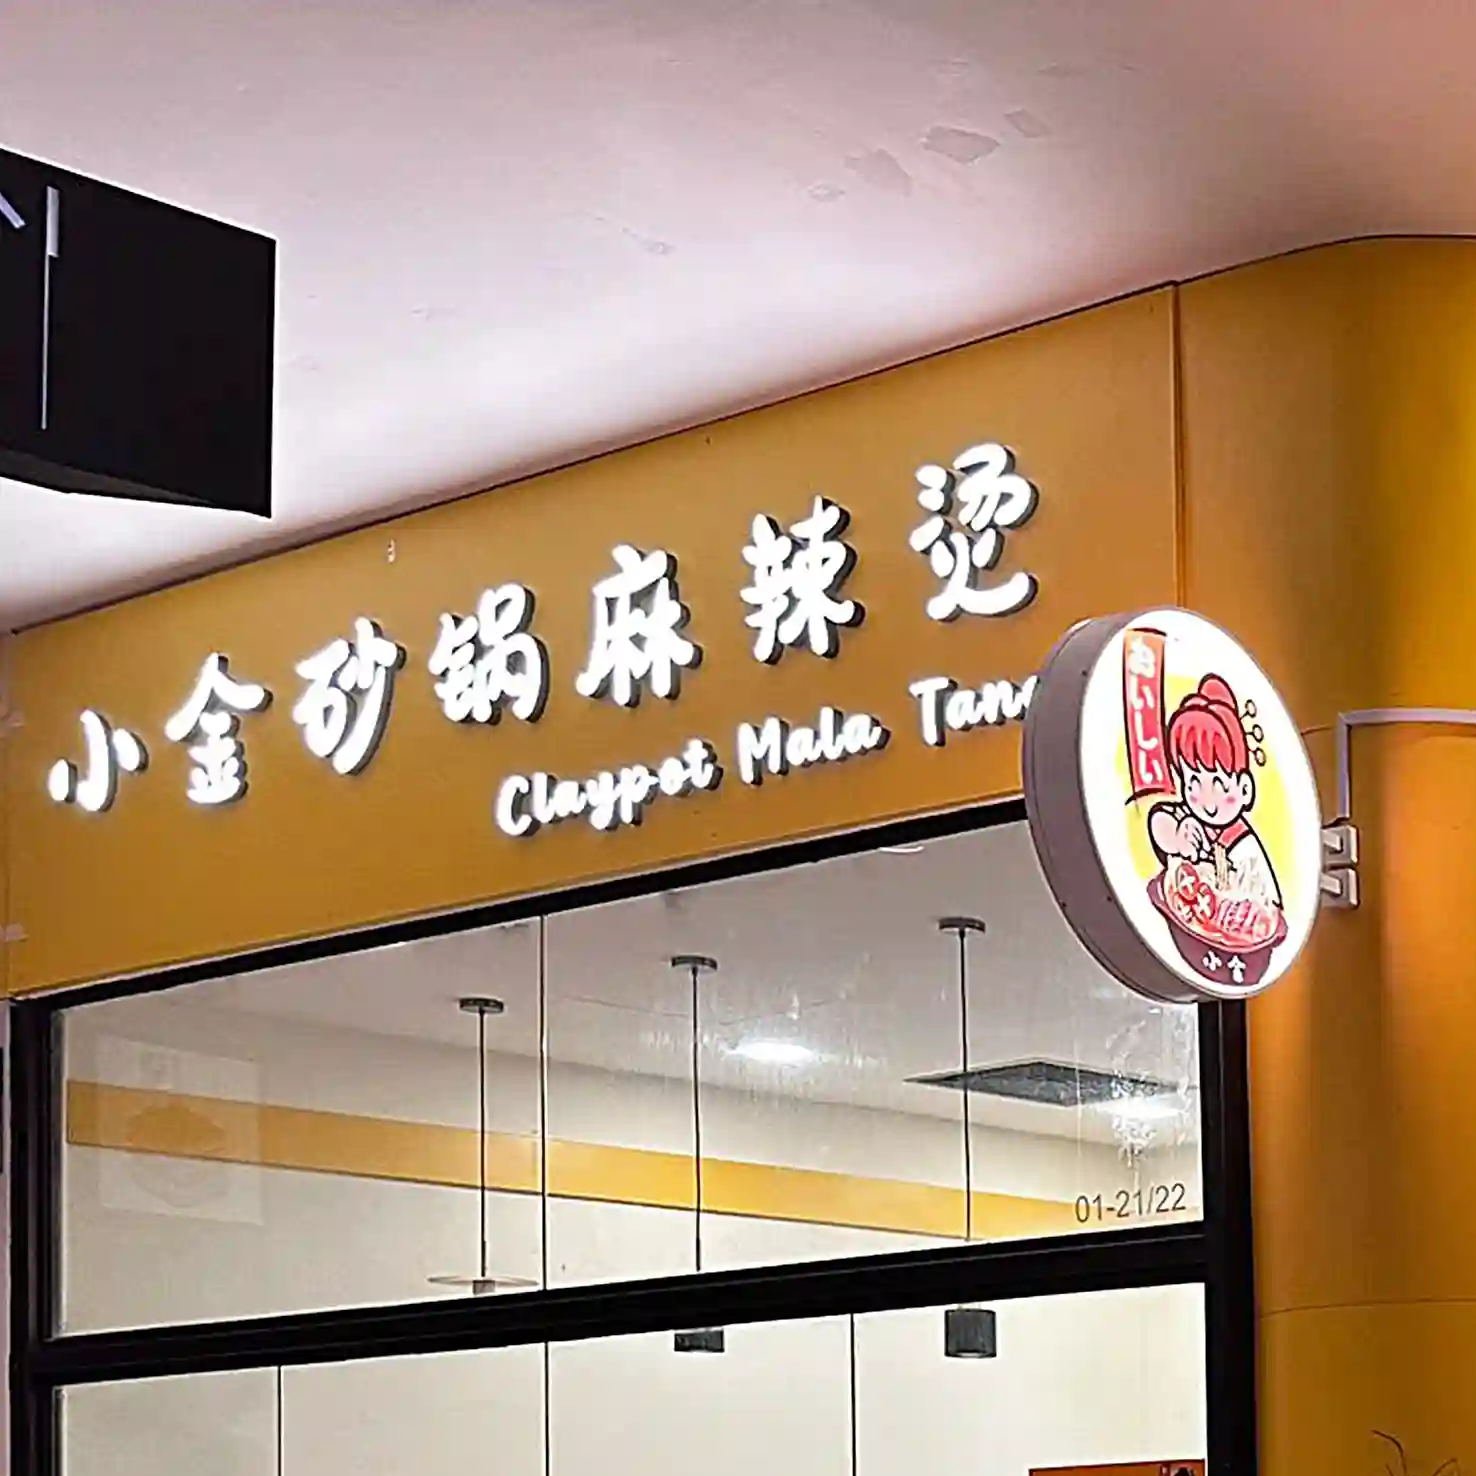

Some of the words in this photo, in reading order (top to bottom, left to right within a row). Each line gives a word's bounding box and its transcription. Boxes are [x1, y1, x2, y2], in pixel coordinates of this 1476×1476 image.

[47, 440, 1038, 815] 小金砂锅麻辣烫
[496, 736, 720, 838] Claypot
[736, 704, 888, 785] Mala
[1075, 1181, 1187, 1224] 01-21/22
